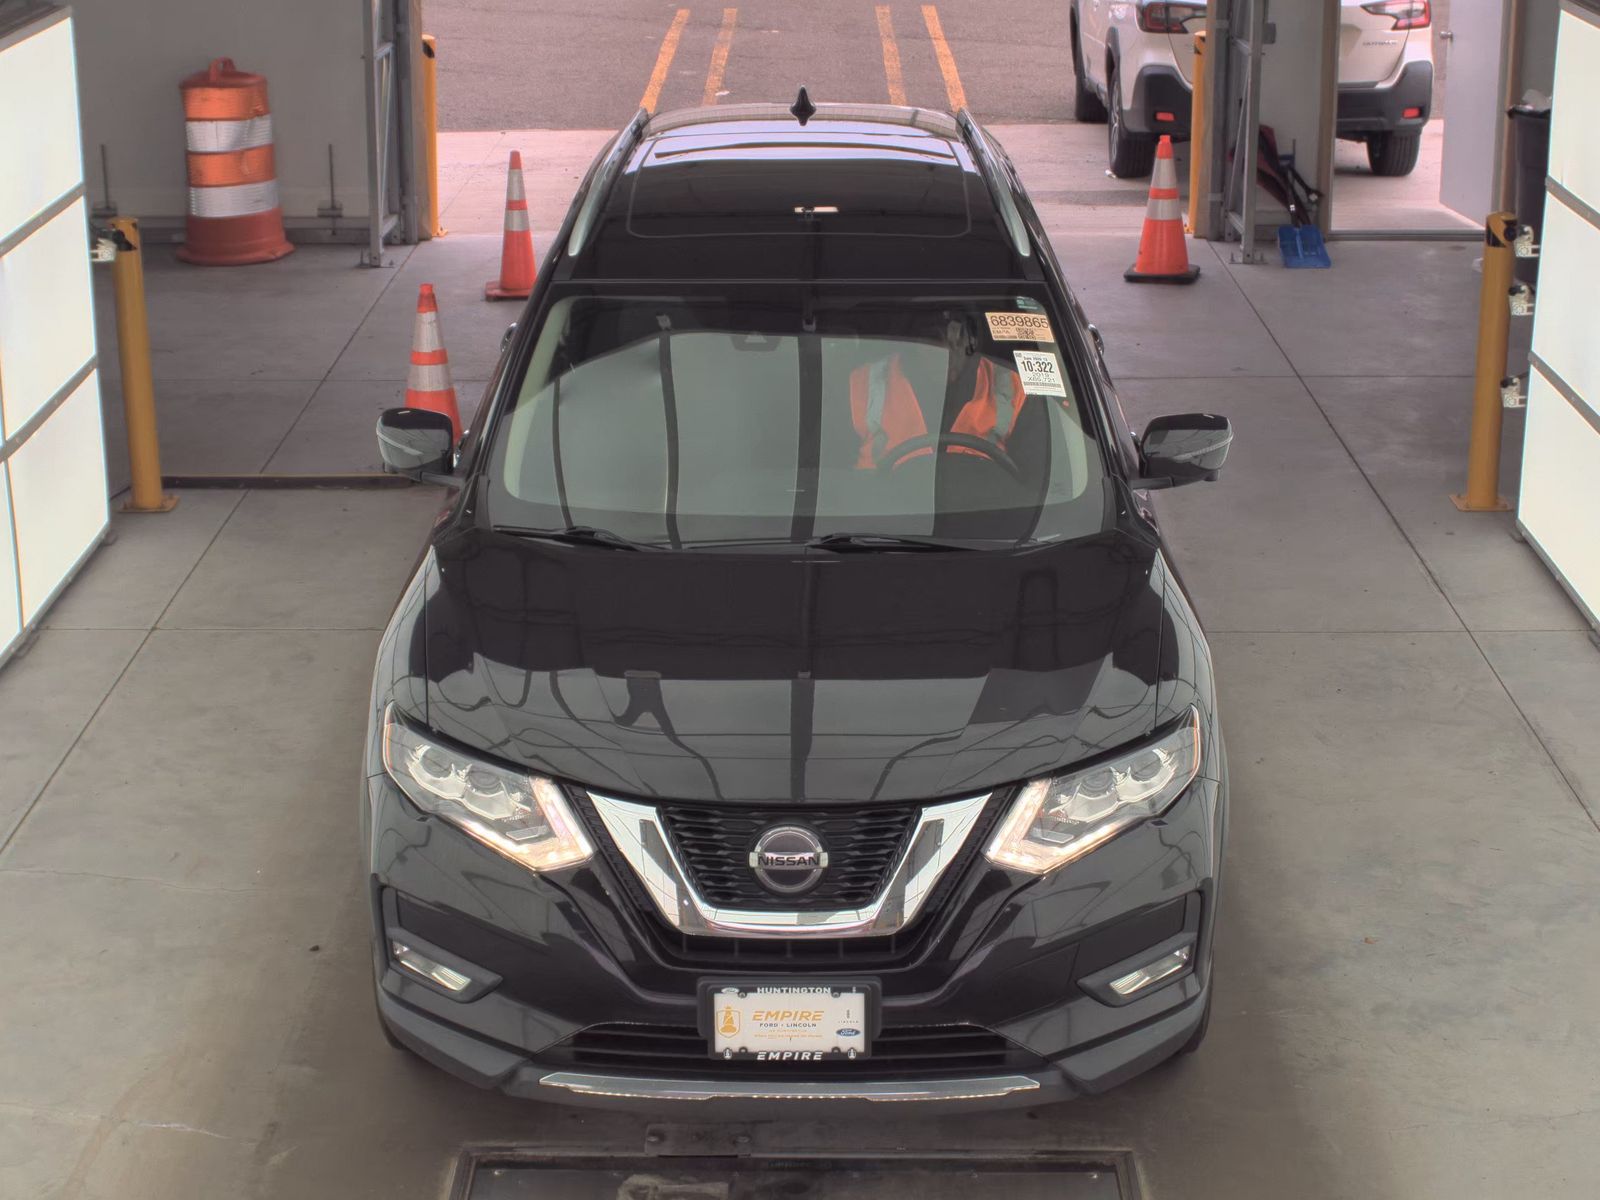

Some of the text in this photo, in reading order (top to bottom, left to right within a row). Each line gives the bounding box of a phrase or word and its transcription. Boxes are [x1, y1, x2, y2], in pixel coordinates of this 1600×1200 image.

[990, 315, 1049, 328] 6839865
[1021, 360, 1055, 373] 10:322
[758, 856, 819, 866] NISSAN
[752, 1010, 825, 1021] EMPIRE
[756, 1051, 824, 1061] EMPIRE
